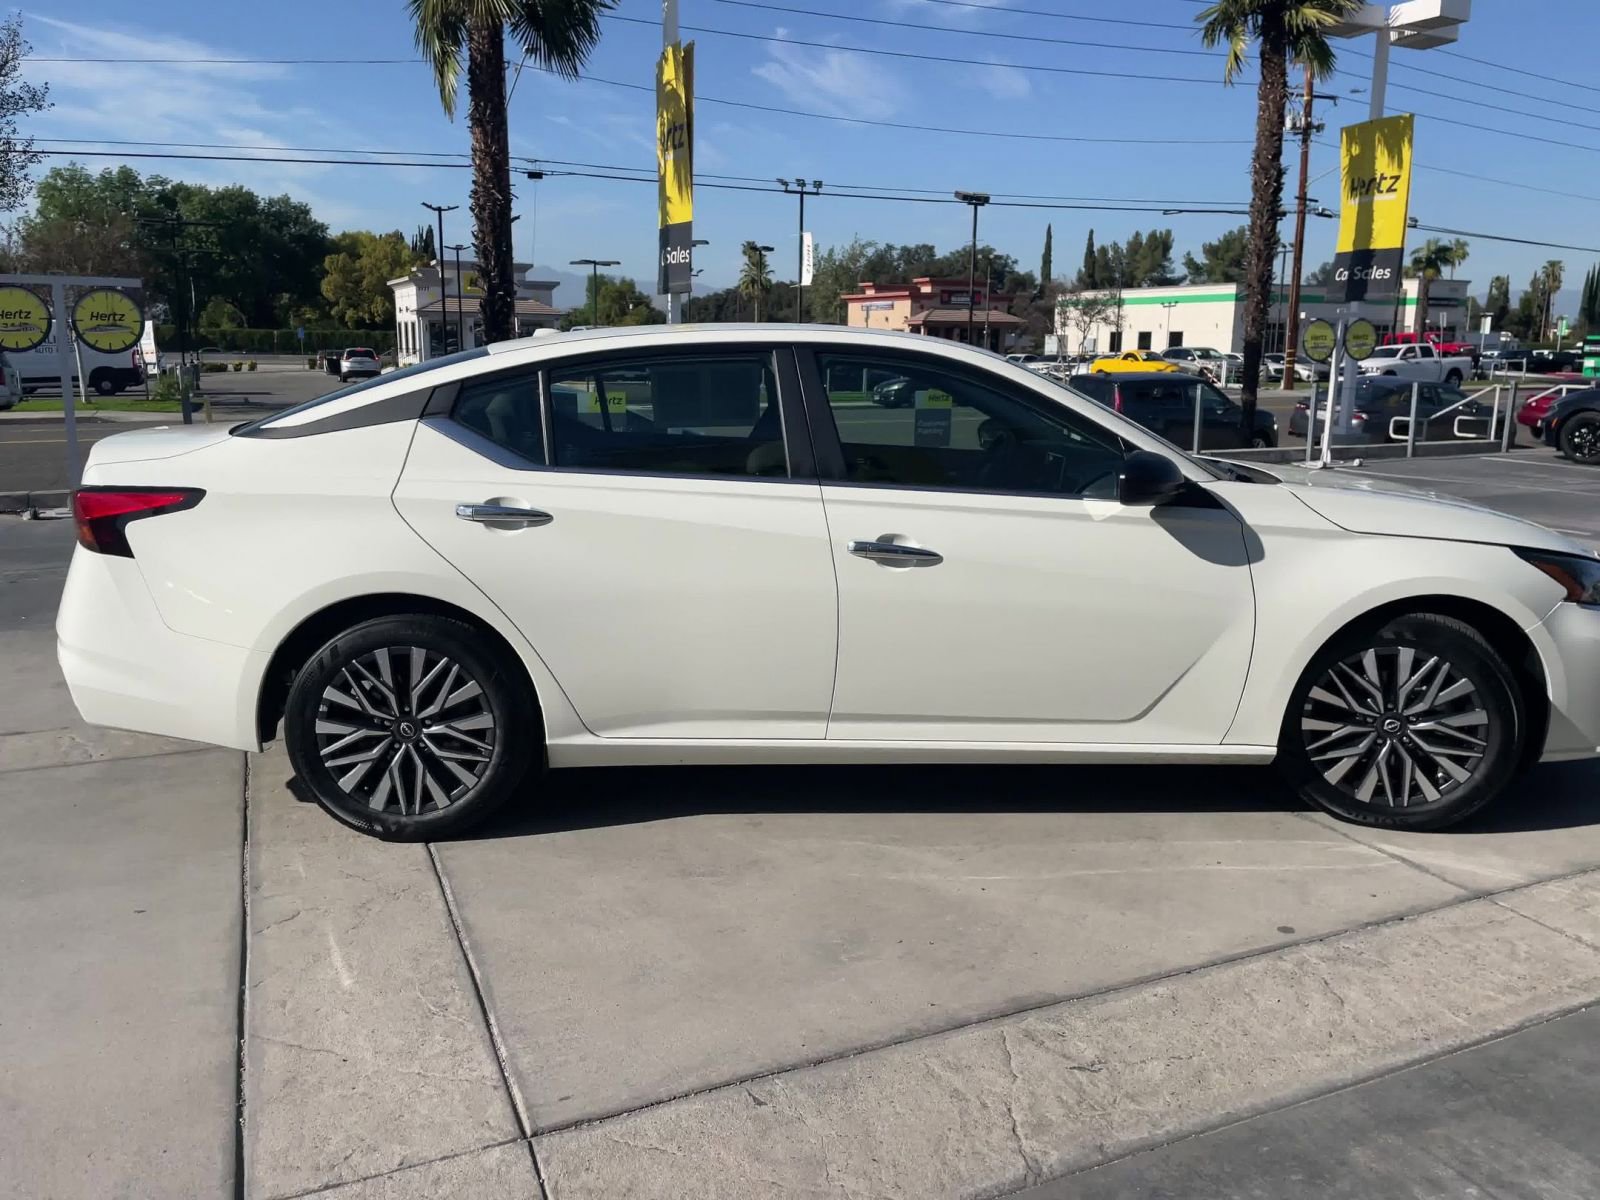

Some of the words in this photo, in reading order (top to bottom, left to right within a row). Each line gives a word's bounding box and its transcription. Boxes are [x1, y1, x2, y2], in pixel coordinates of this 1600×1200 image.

[666, 246, 690, 264] Sales
[1334, 267, 1349, 281] Ca
[1353, 265, 1391, 280] Sales
[90, 311, 126, 322] Hertz
[594, 396, 623, 406] Hrtz
